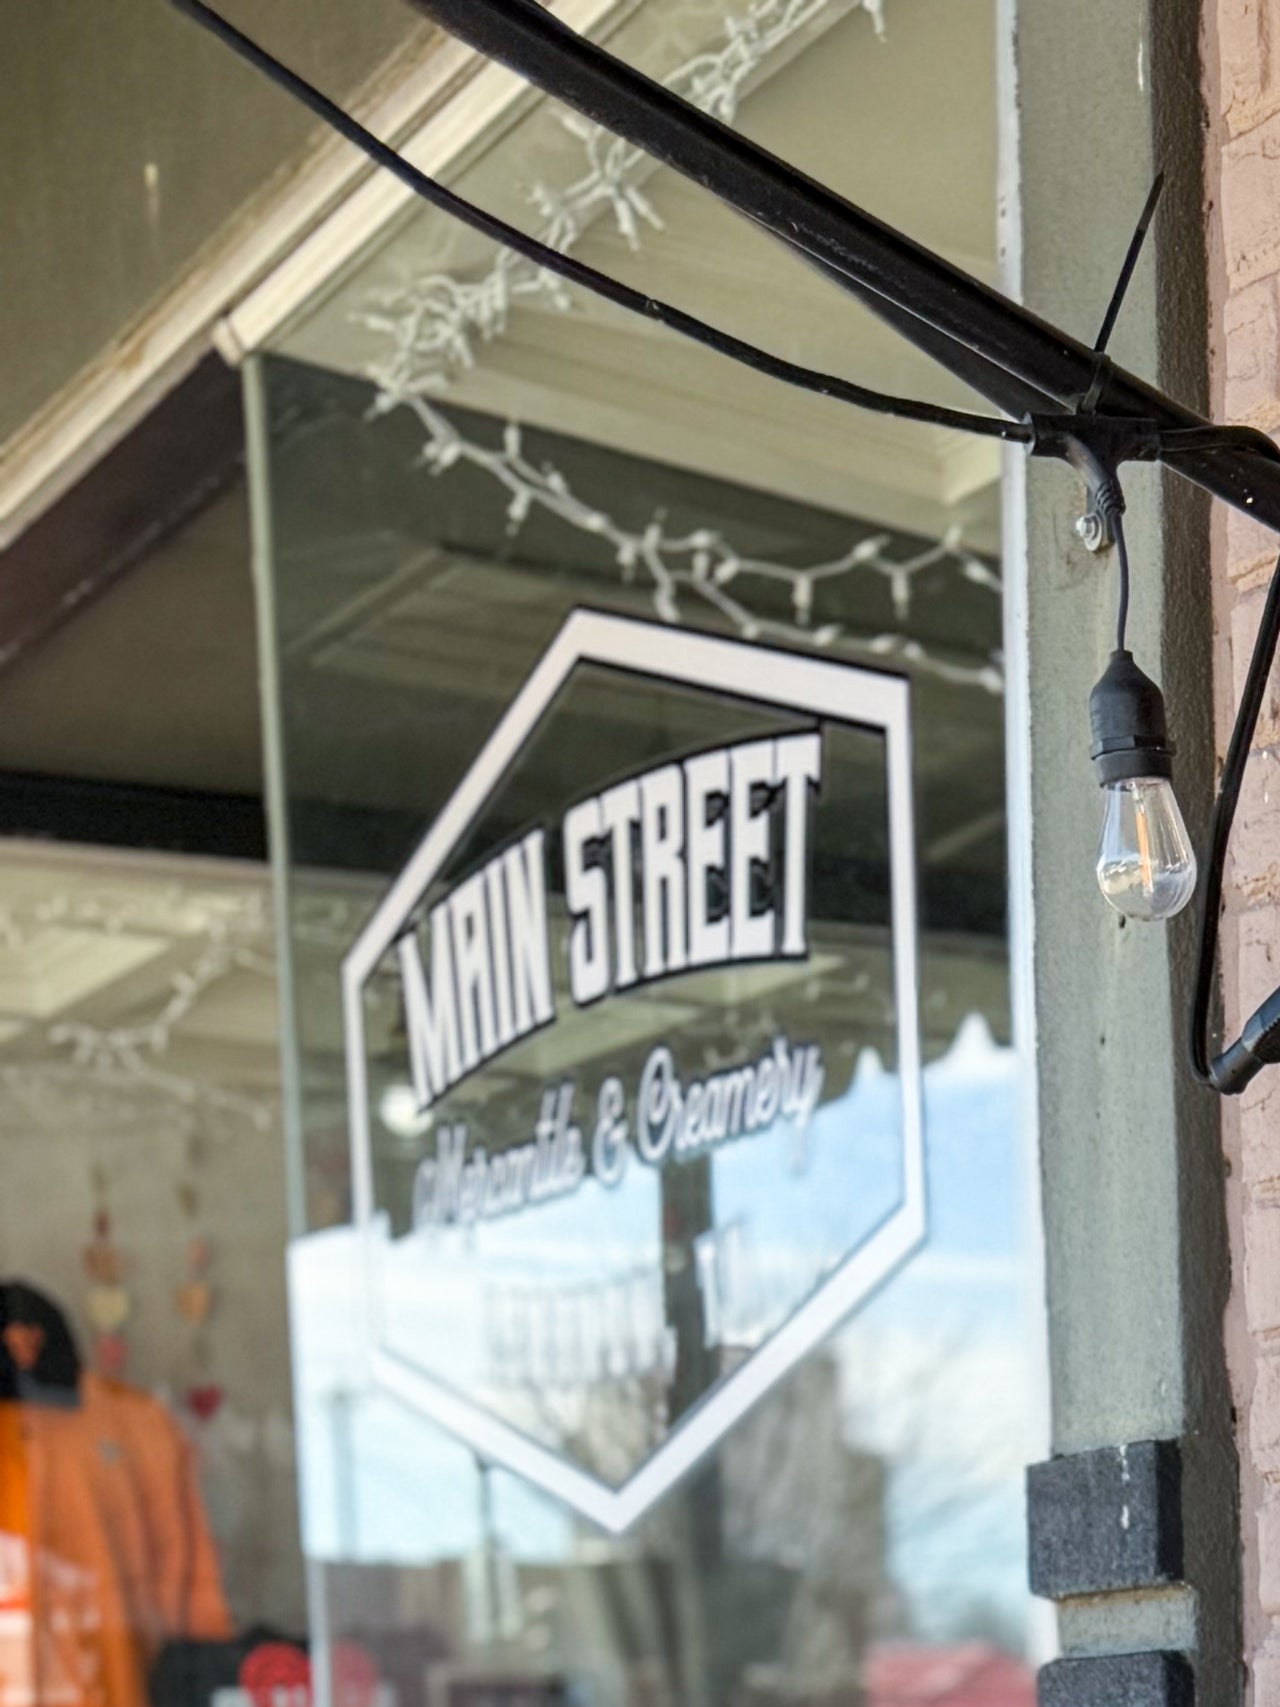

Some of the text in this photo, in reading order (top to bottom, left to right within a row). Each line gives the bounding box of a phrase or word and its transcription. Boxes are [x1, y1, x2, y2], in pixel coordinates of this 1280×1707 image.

[400, 730, 822, 1112] MAIN STREET
[637, 1036, 826, 1168] Creamery
